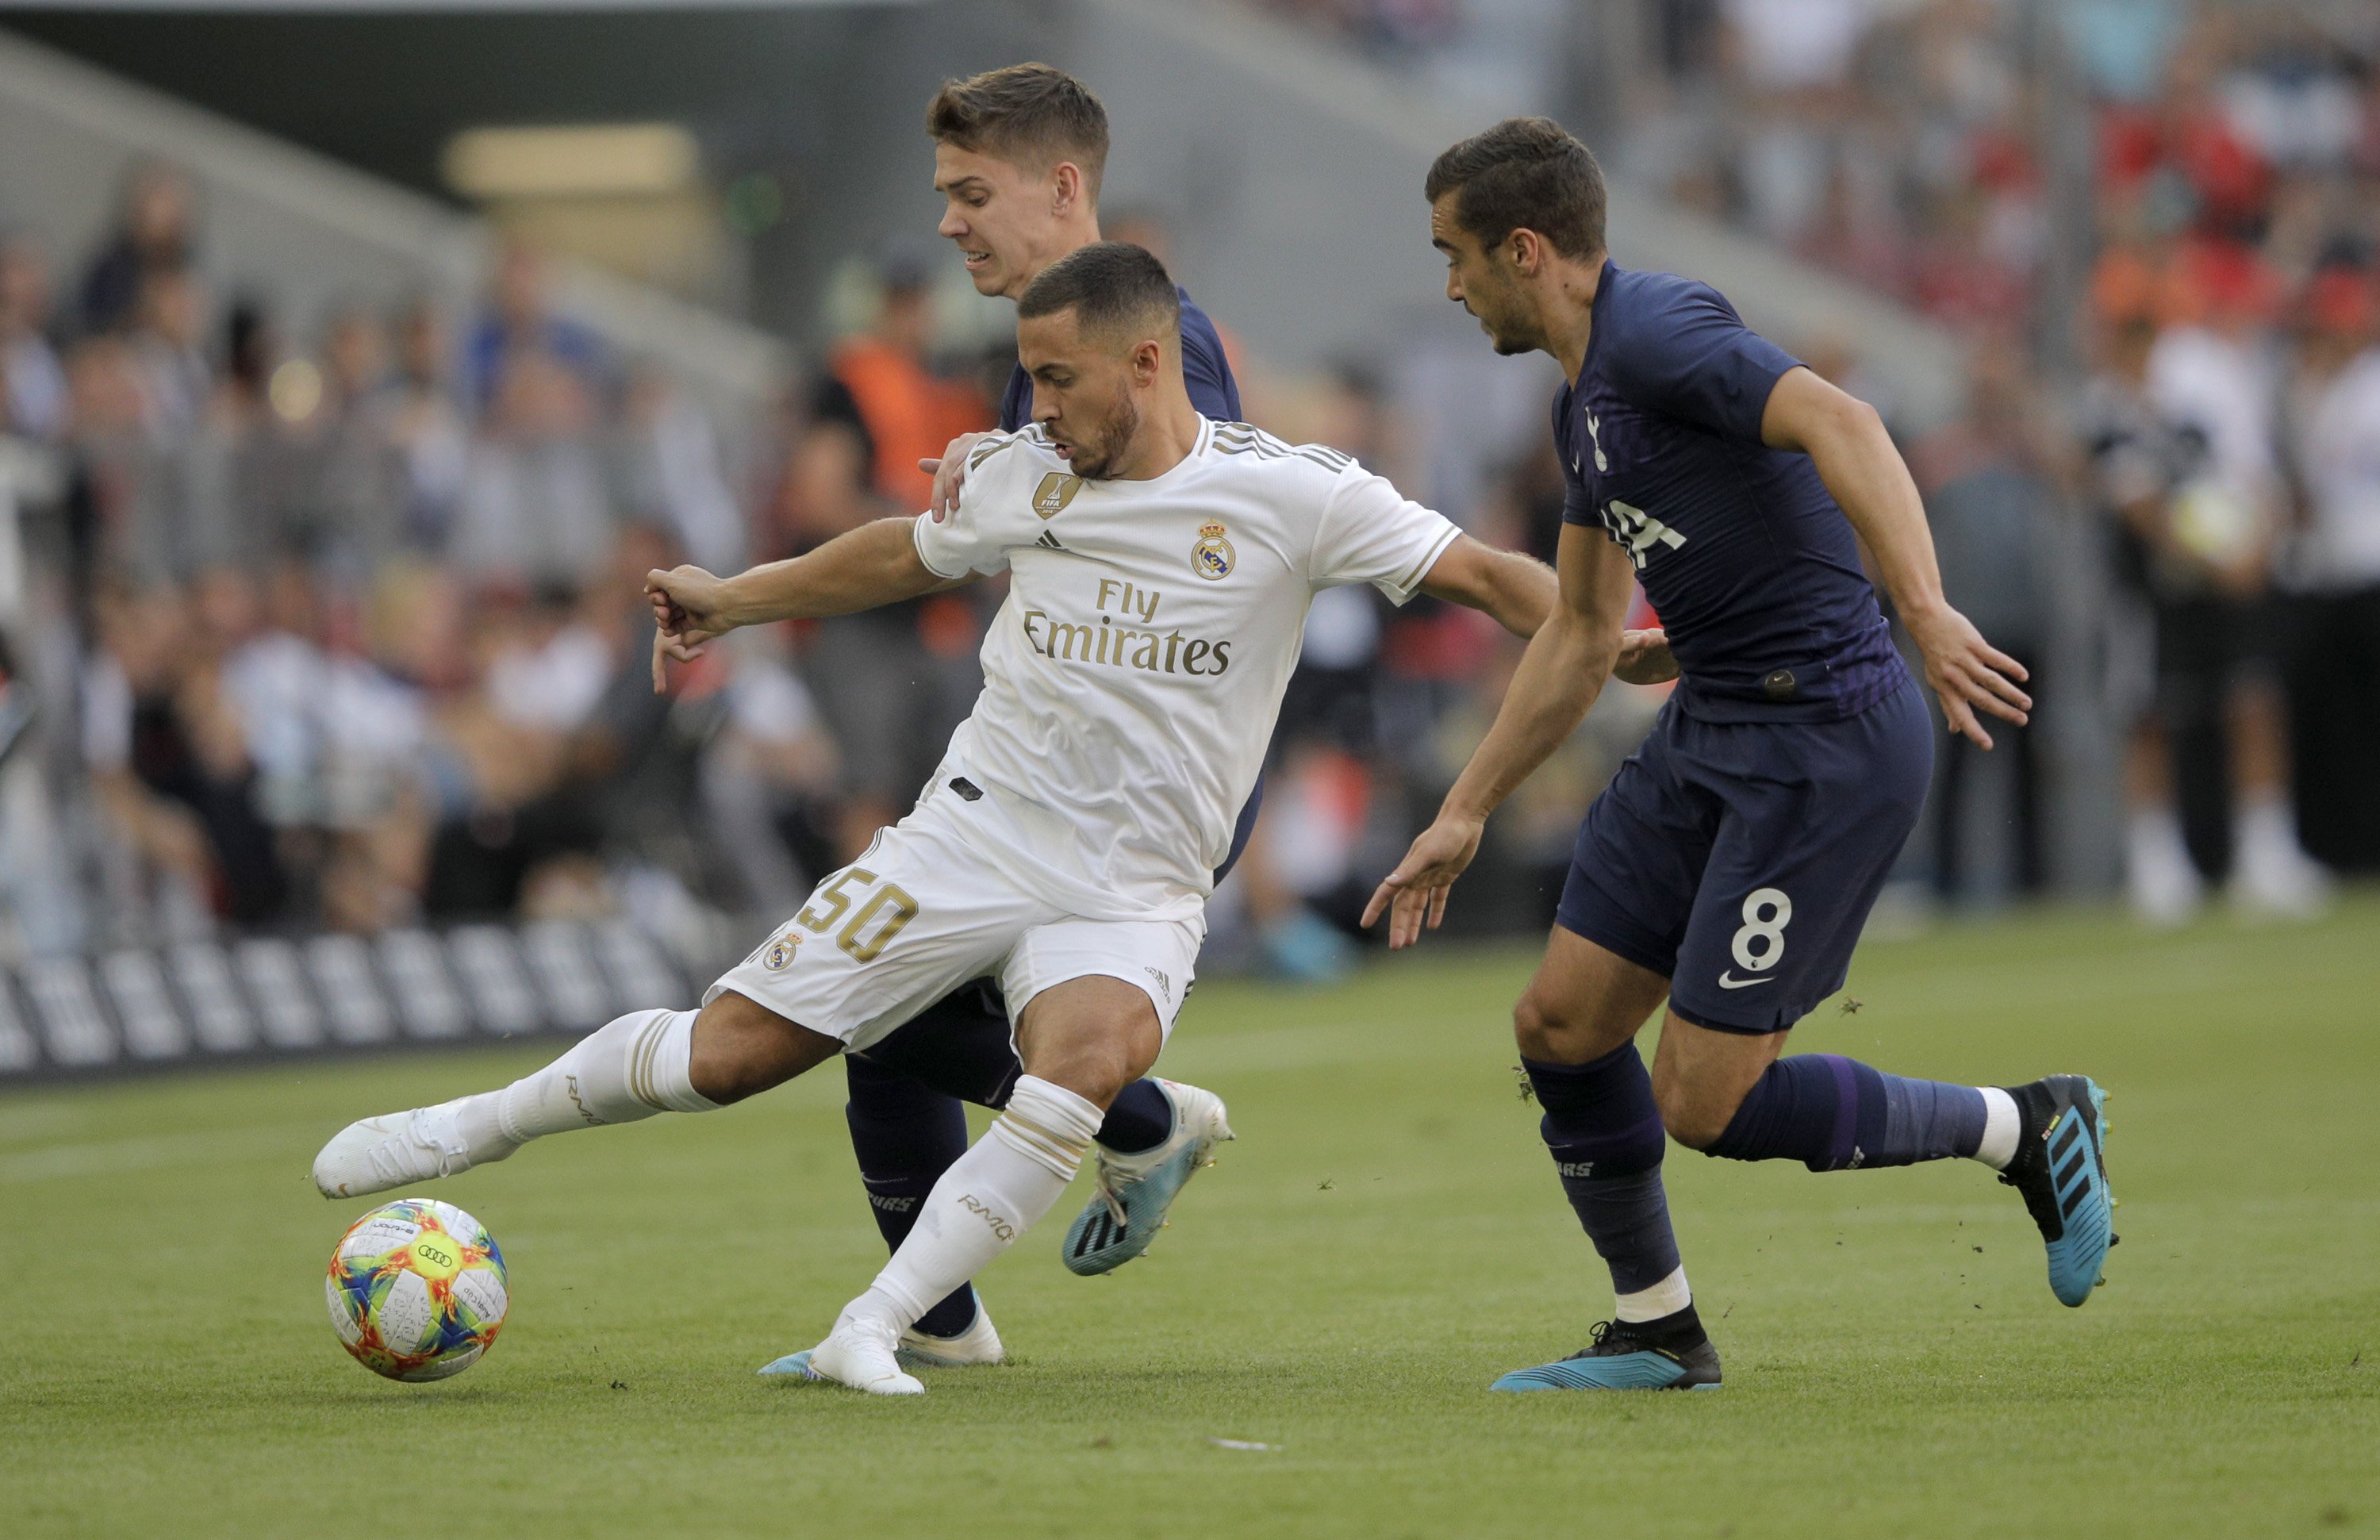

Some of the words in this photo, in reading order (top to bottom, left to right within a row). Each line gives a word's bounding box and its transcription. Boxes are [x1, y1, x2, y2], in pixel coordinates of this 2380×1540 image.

[1096, 578, 1161, 623] Fly
[1023, 610, 1231, 676] Emirates
[797, 866, 919, 965] 50
[1731, 887, 1792, 972] 8
[1144, 966, 1171, 1004] adidas
